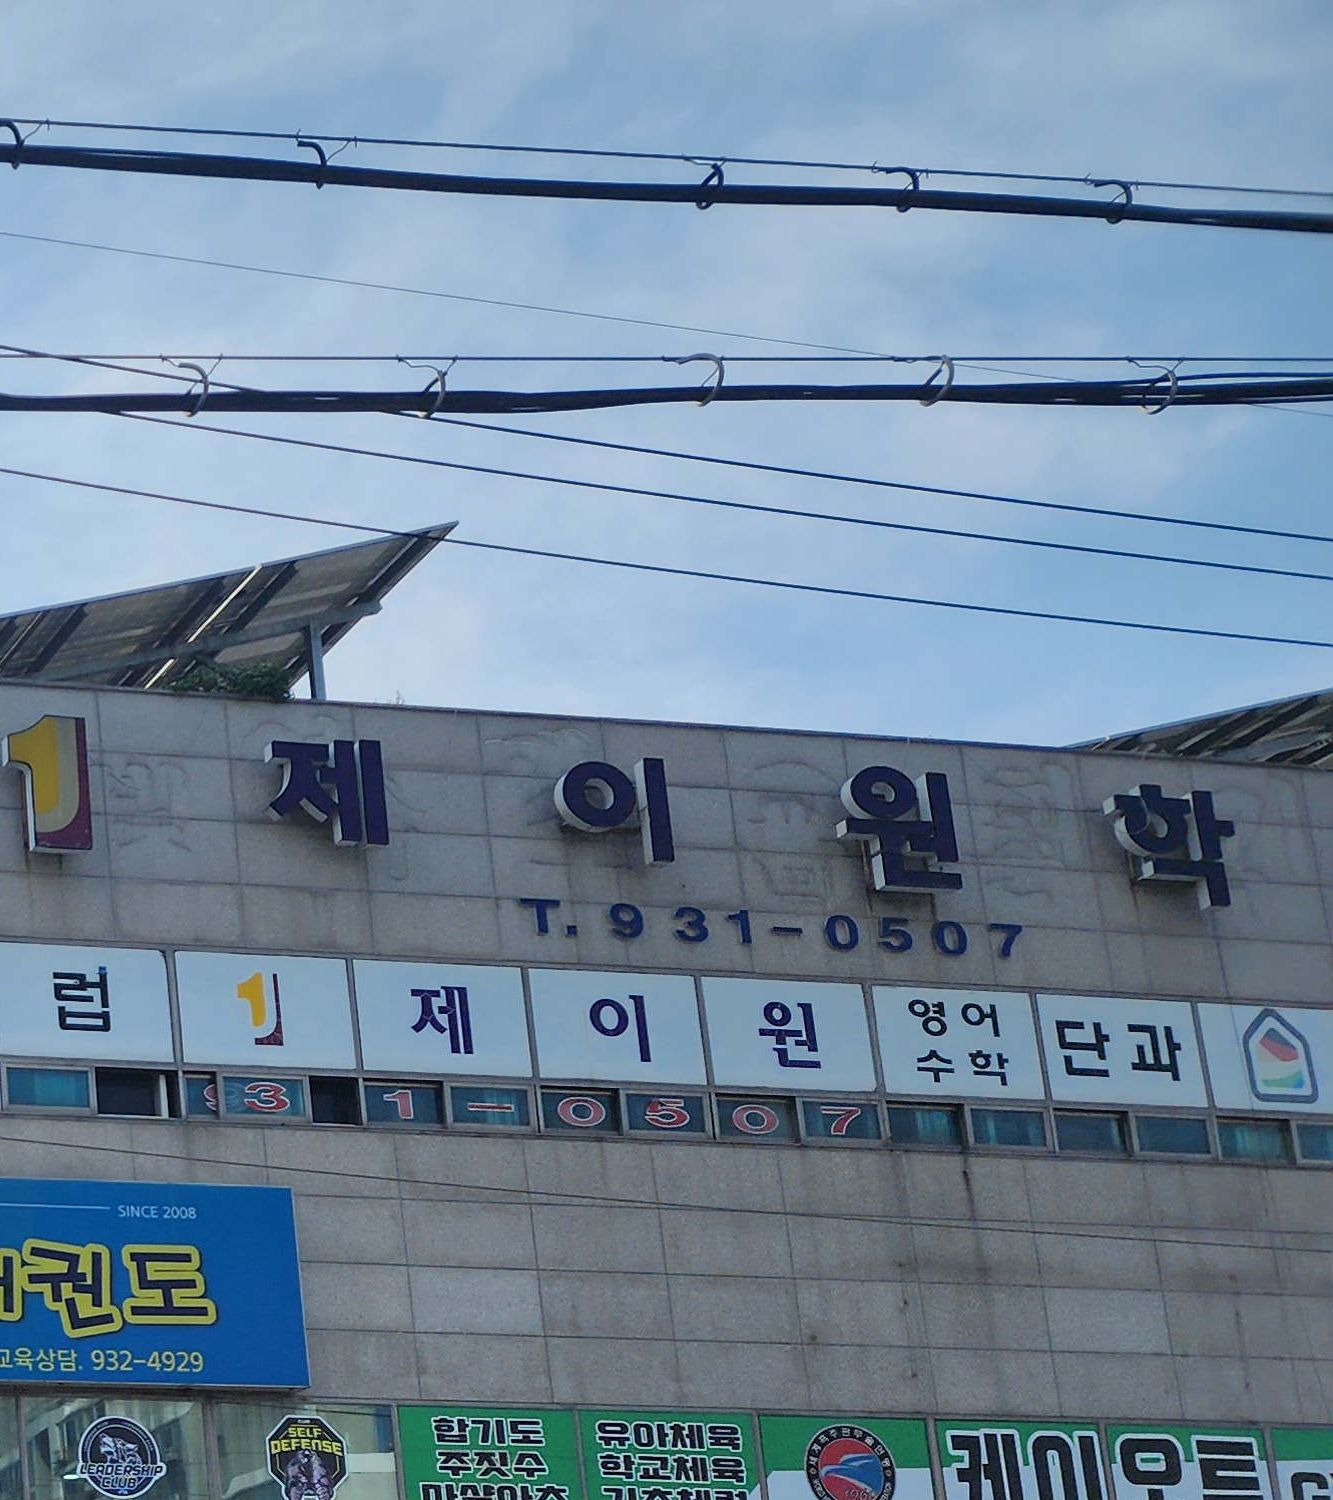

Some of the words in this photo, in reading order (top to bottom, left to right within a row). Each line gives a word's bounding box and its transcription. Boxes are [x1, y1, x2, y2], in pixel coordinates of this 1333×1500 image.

[908, 999, 1001, 1037] 영어
[1055, 1019, 1182, 1081] 단과
[916, 1049, 1009, 1086] 수학
[117, 1204, 160, 1220] SINCE
[162, 1206, 198, 1220] 2008
[90, 1350, 205, 1374] 932-4929
[270, 1438, 344, 1456] DEFENSE
[288, 1427, 323, 1439] SELF
[431, 1416, 546, 1448] 합기도
[595, 1419, 743, 1453] 유아체육
[80, 1463, 165, 1477] LEADERSHIP
[436, 1449, 550, 1480] 주짓수
[598, 1452, 748, 1485] 학교체육
[100, 1477, 139, 1489] CLUB
